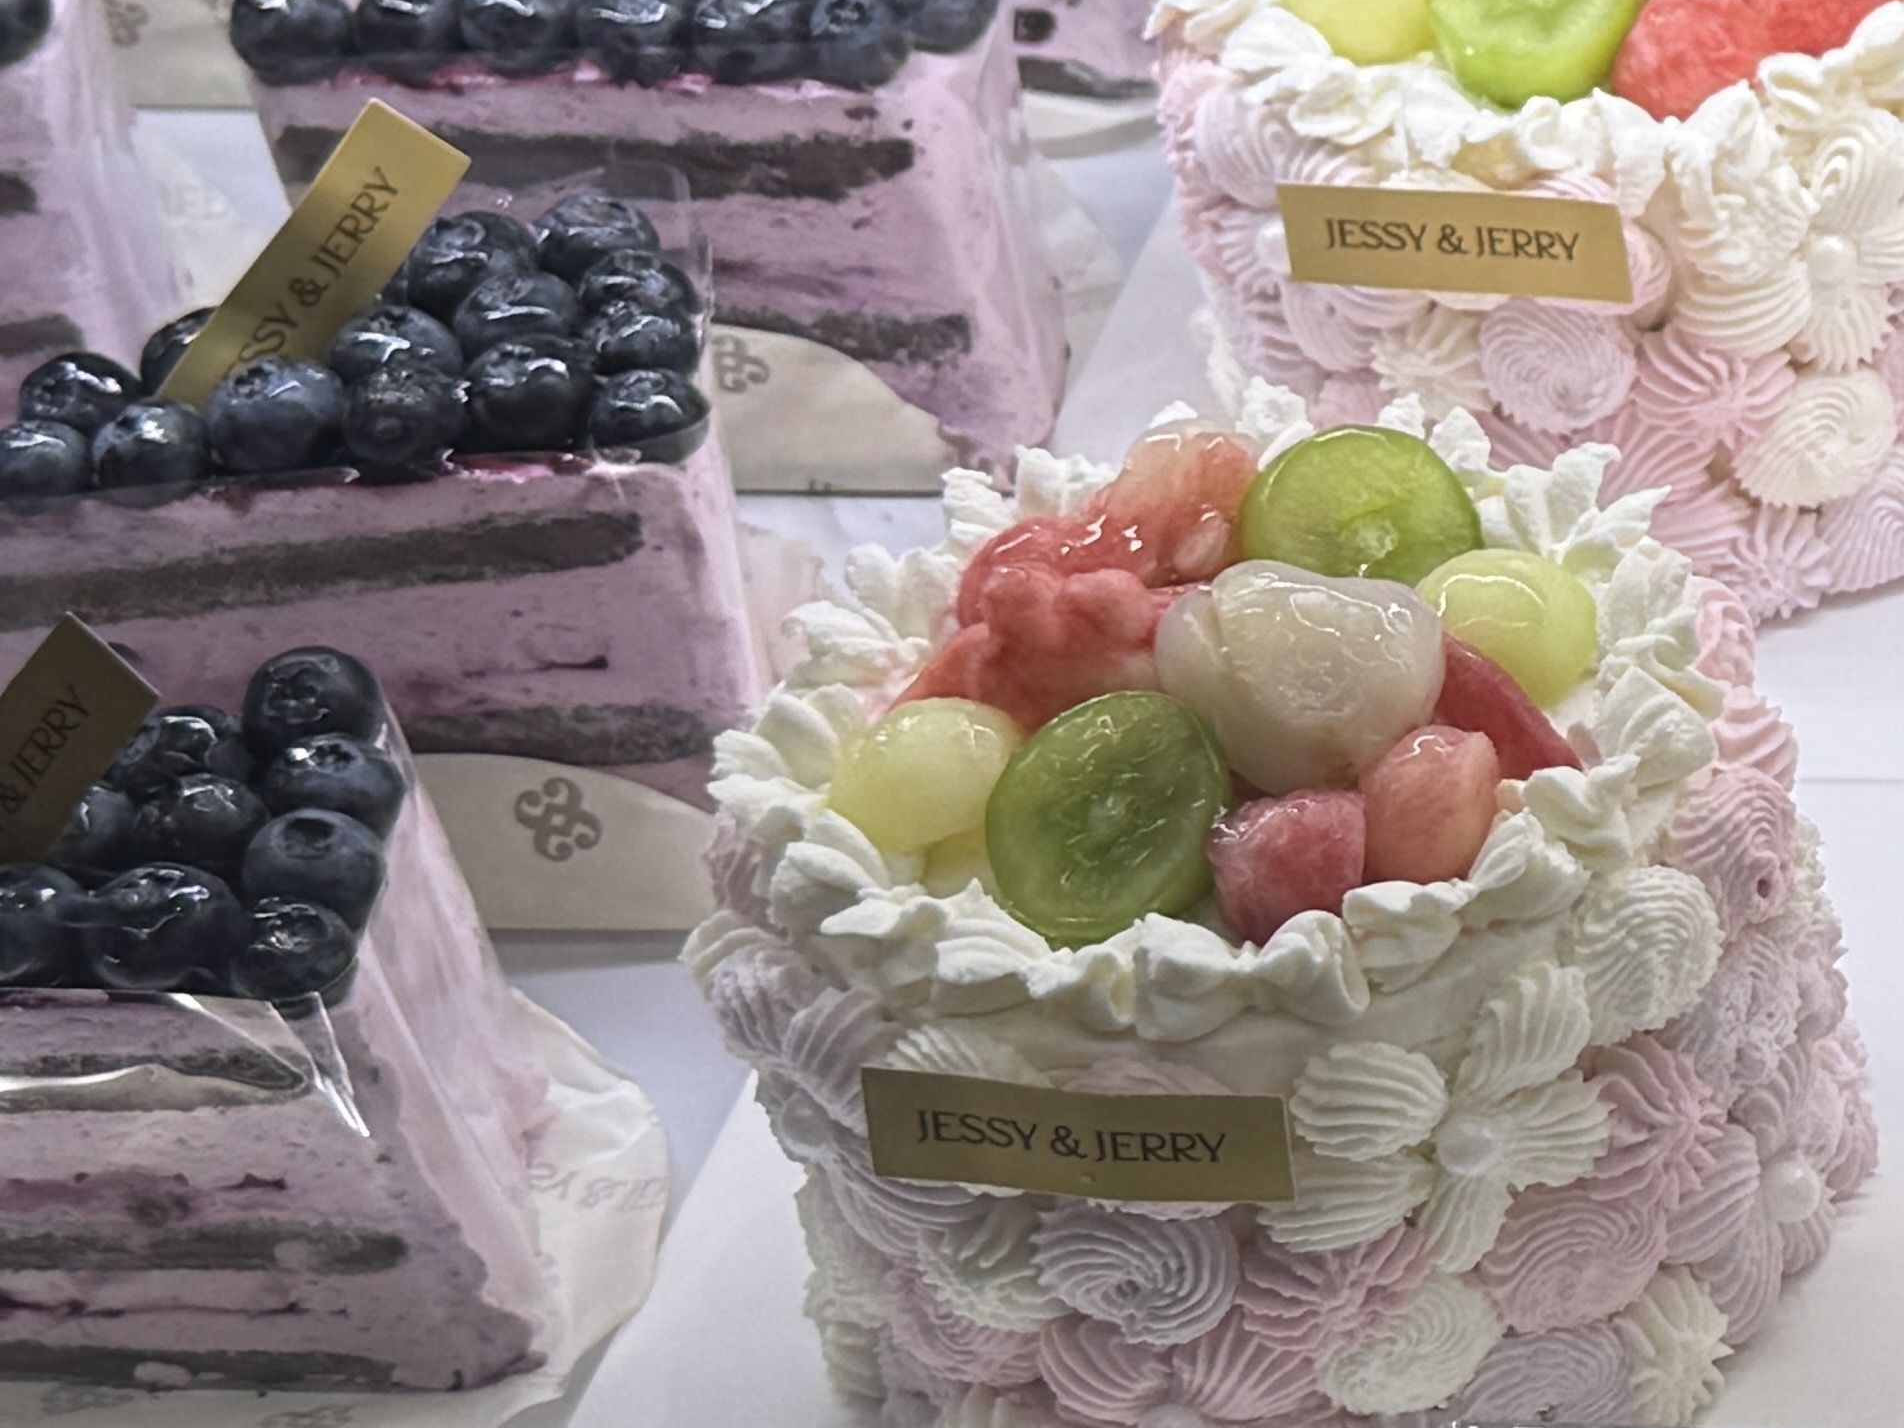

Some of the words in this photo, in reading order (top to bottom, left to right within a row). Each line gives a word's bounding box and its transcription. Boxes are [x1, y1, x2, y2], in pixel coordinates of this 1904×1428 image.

[288, 276, 329, 307] &
[310, 165, 399, 277] JERRY
[1325, 218, 1427, 252] JESSY
[1436, 223, 1468, 256] &
[1476, 226, 1580, 261] JERRY
[10, 682, 91, 788] JERRY
[917, 1109, 1038, 1152] JESSY
[1049, 1124, 1088, 1160] &
[1096, 1130, 1227, 1164] JERRY
